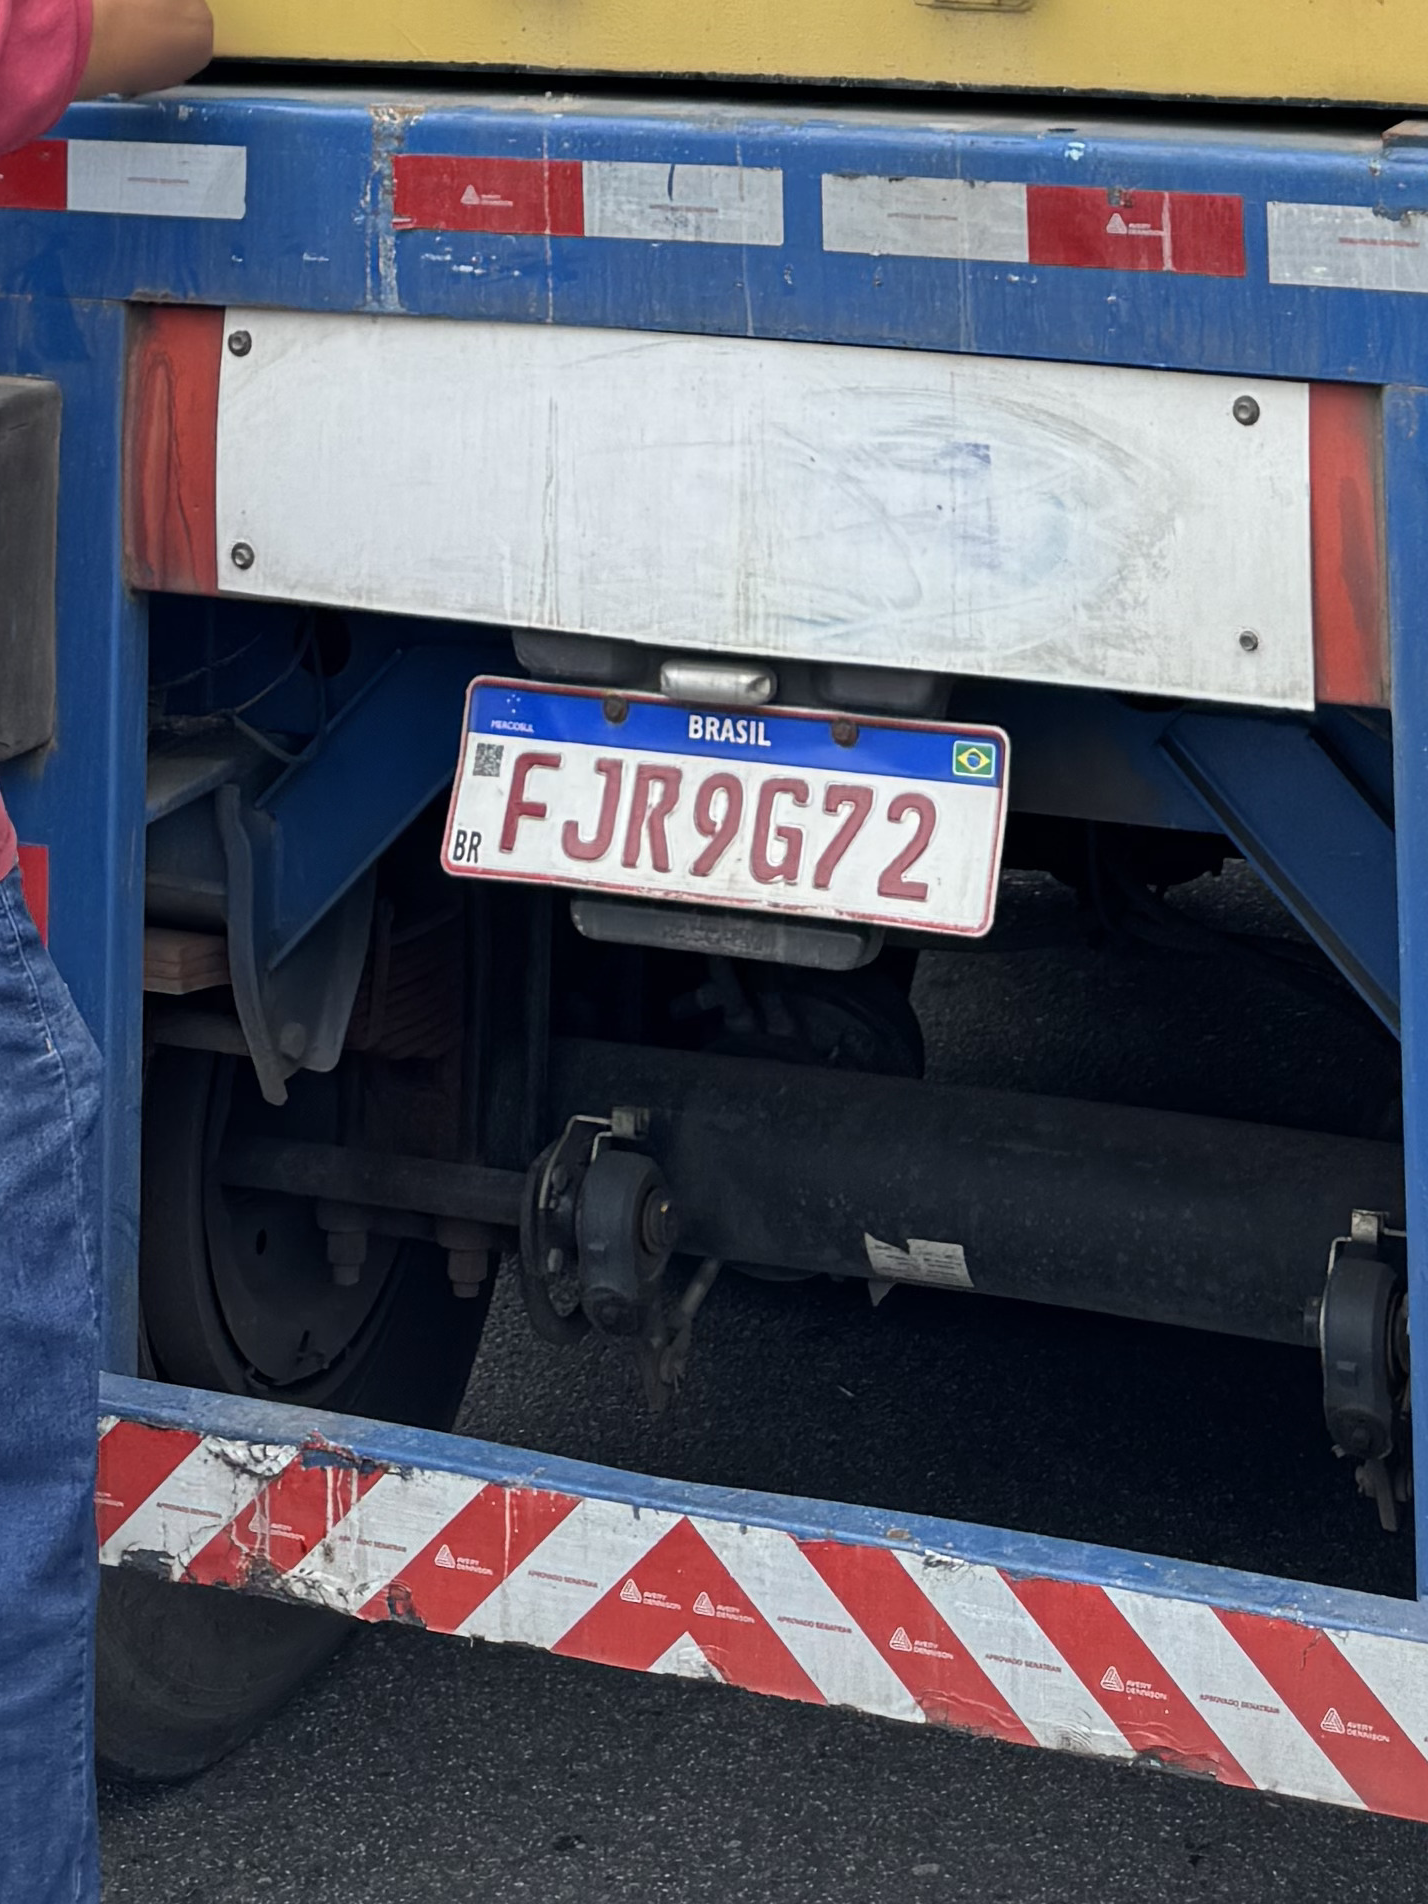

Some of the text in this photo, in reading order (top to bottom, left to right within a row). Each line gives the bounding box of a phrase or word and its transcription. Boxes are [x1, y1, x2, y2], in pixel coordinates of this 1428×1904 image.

[689, 715, 771, 747] BRASIL
[499, 752, 938, 902] FJR9G72
[453, 829, 483, 864] BR
